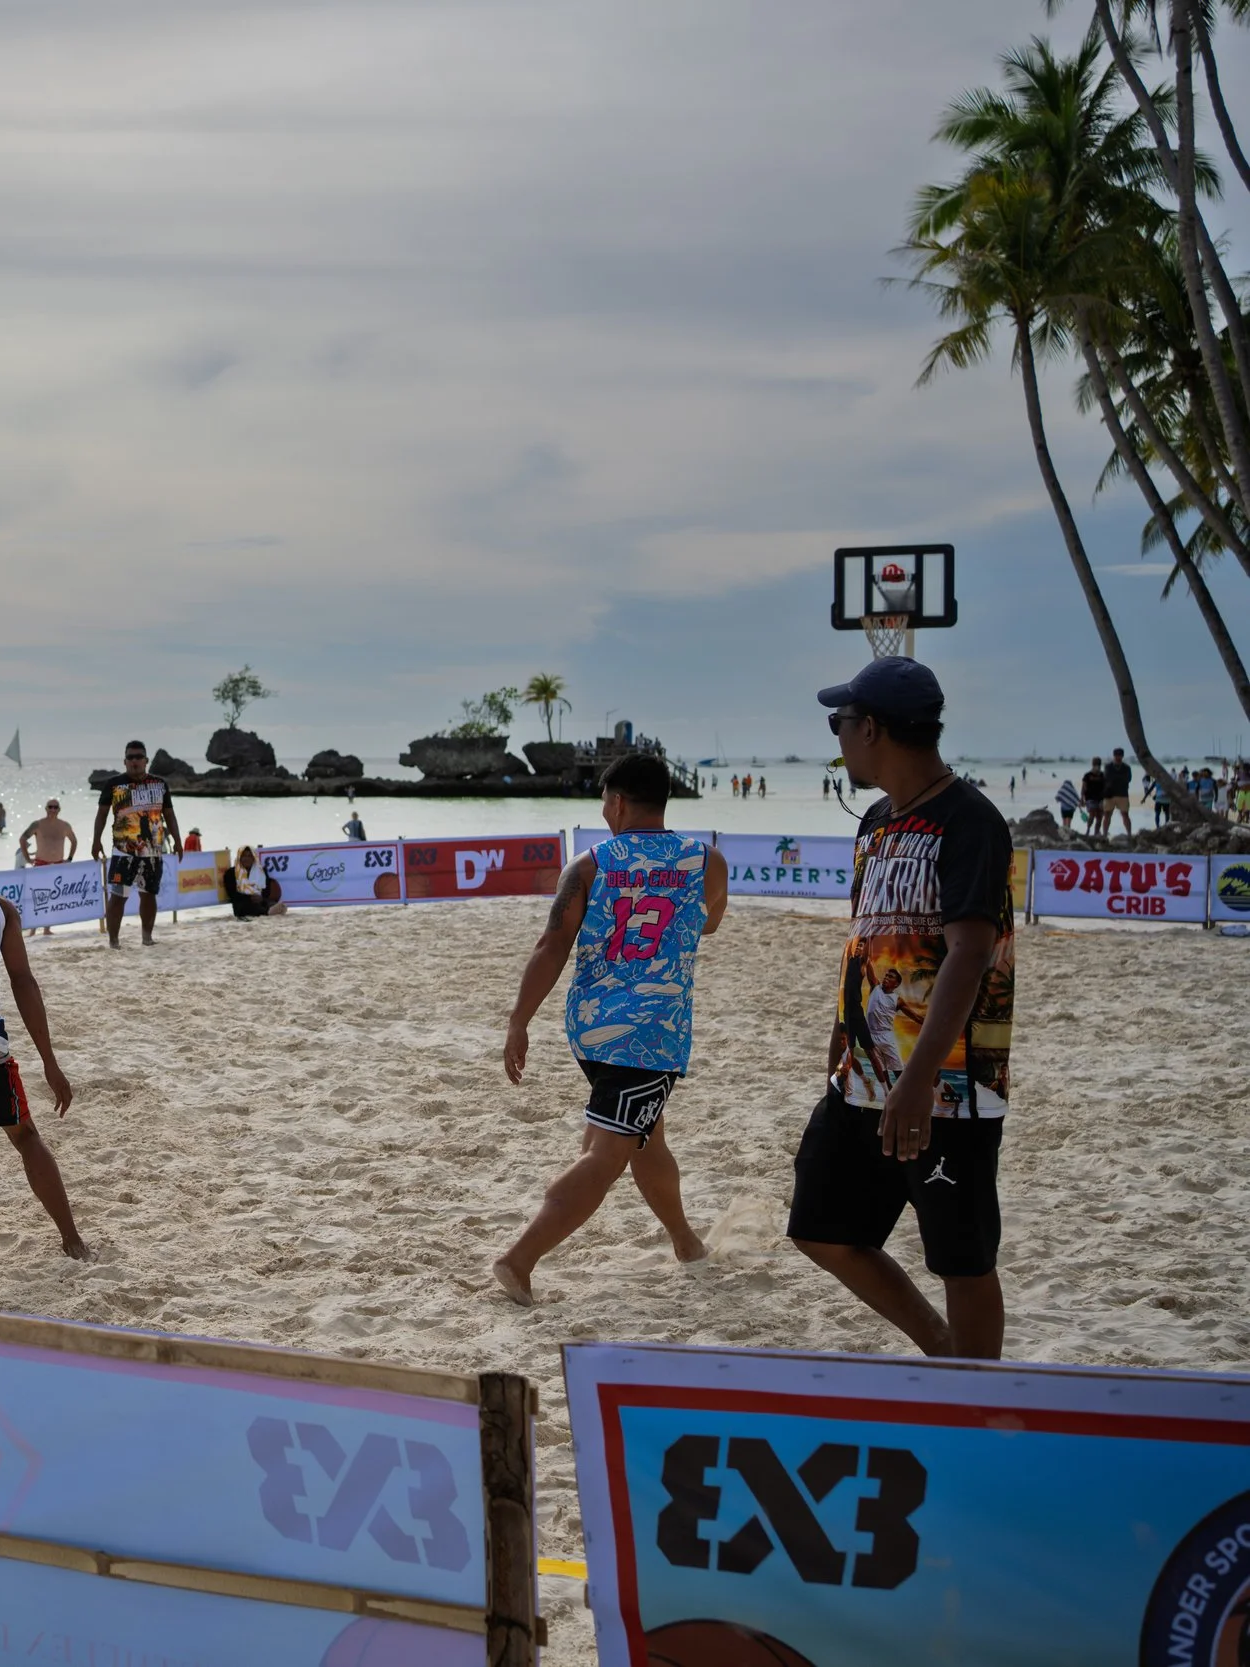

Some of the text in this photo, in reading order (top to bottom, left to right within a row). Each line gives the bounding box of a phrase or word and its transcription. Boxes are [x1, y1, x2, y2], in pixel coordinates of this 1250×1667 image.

[606, 870, 690, 888] DELA CRUZ
[730, 866, 847, 884] JASPER'S
[50, 873, 98, 900] Sandy's
[50, 899, 99, 912] MINIMART
[1106, 895, 1166, 915] CRIB
[604, 896, 677, 963] 13
